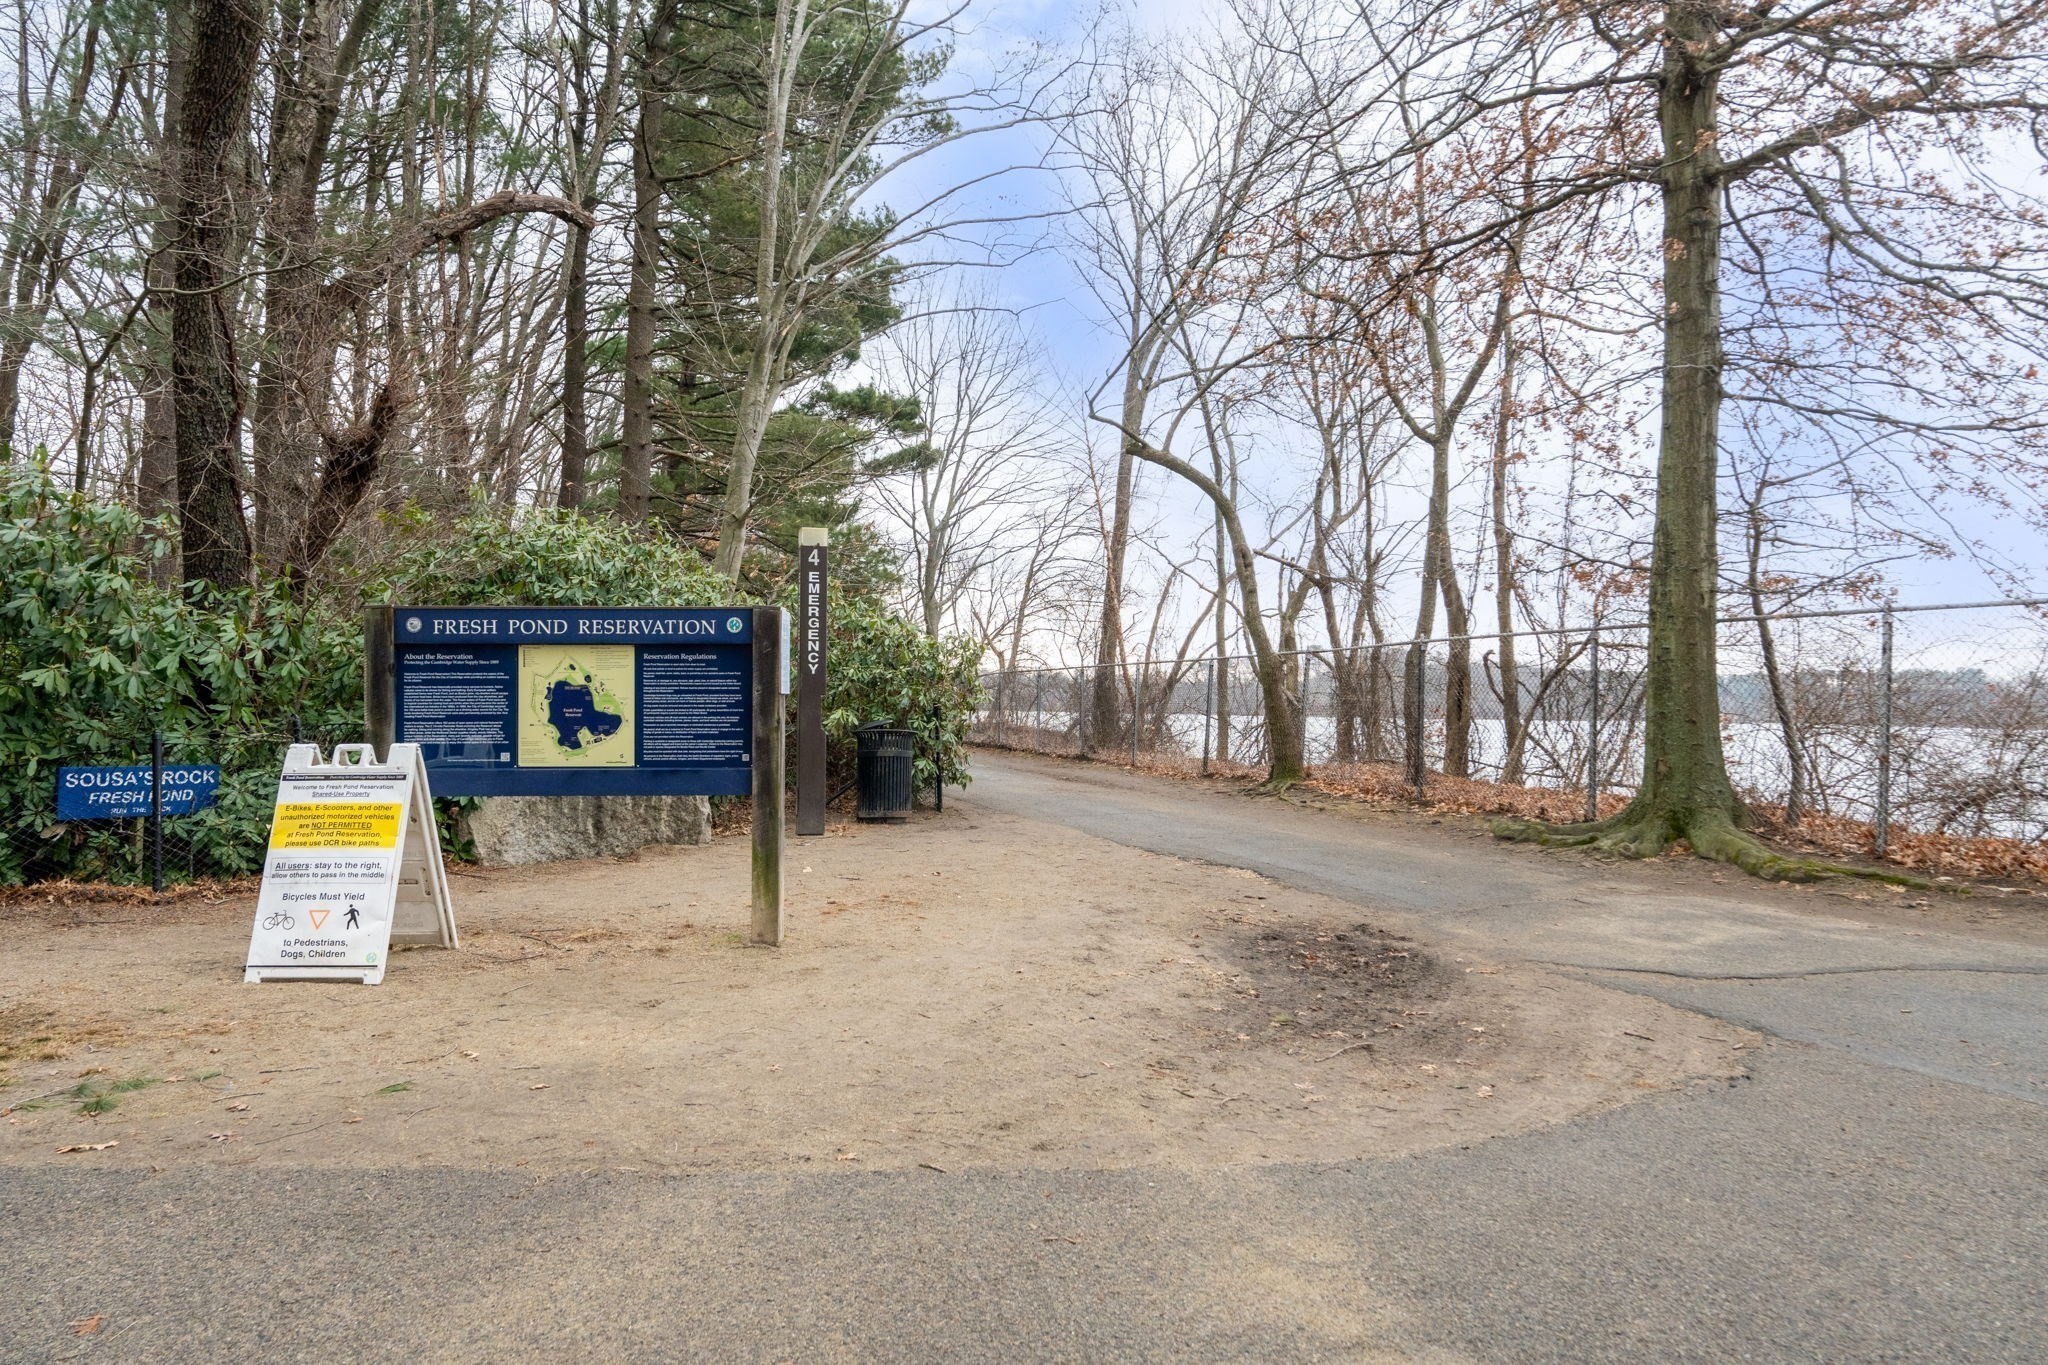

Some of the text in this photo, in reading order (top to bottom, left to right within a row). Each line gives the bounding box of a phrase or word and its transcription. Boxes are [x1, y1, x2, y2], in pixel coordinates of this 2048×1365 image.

[808, 549, 820, 674] 4 EMERGENCY
[433, 620, 716, 634] FRESH POND RESERVATION
[66, 770, 215, 787] SOUSA'S ROCK
[88, 790, 194, 804] FRESH OND
[360, 862, 382, 870] right,
[282, 893, 317, 901] Bicycles
[294, 939, 348, 947] Pedestrians,
[281, 950, 305, 959] Dogs,
